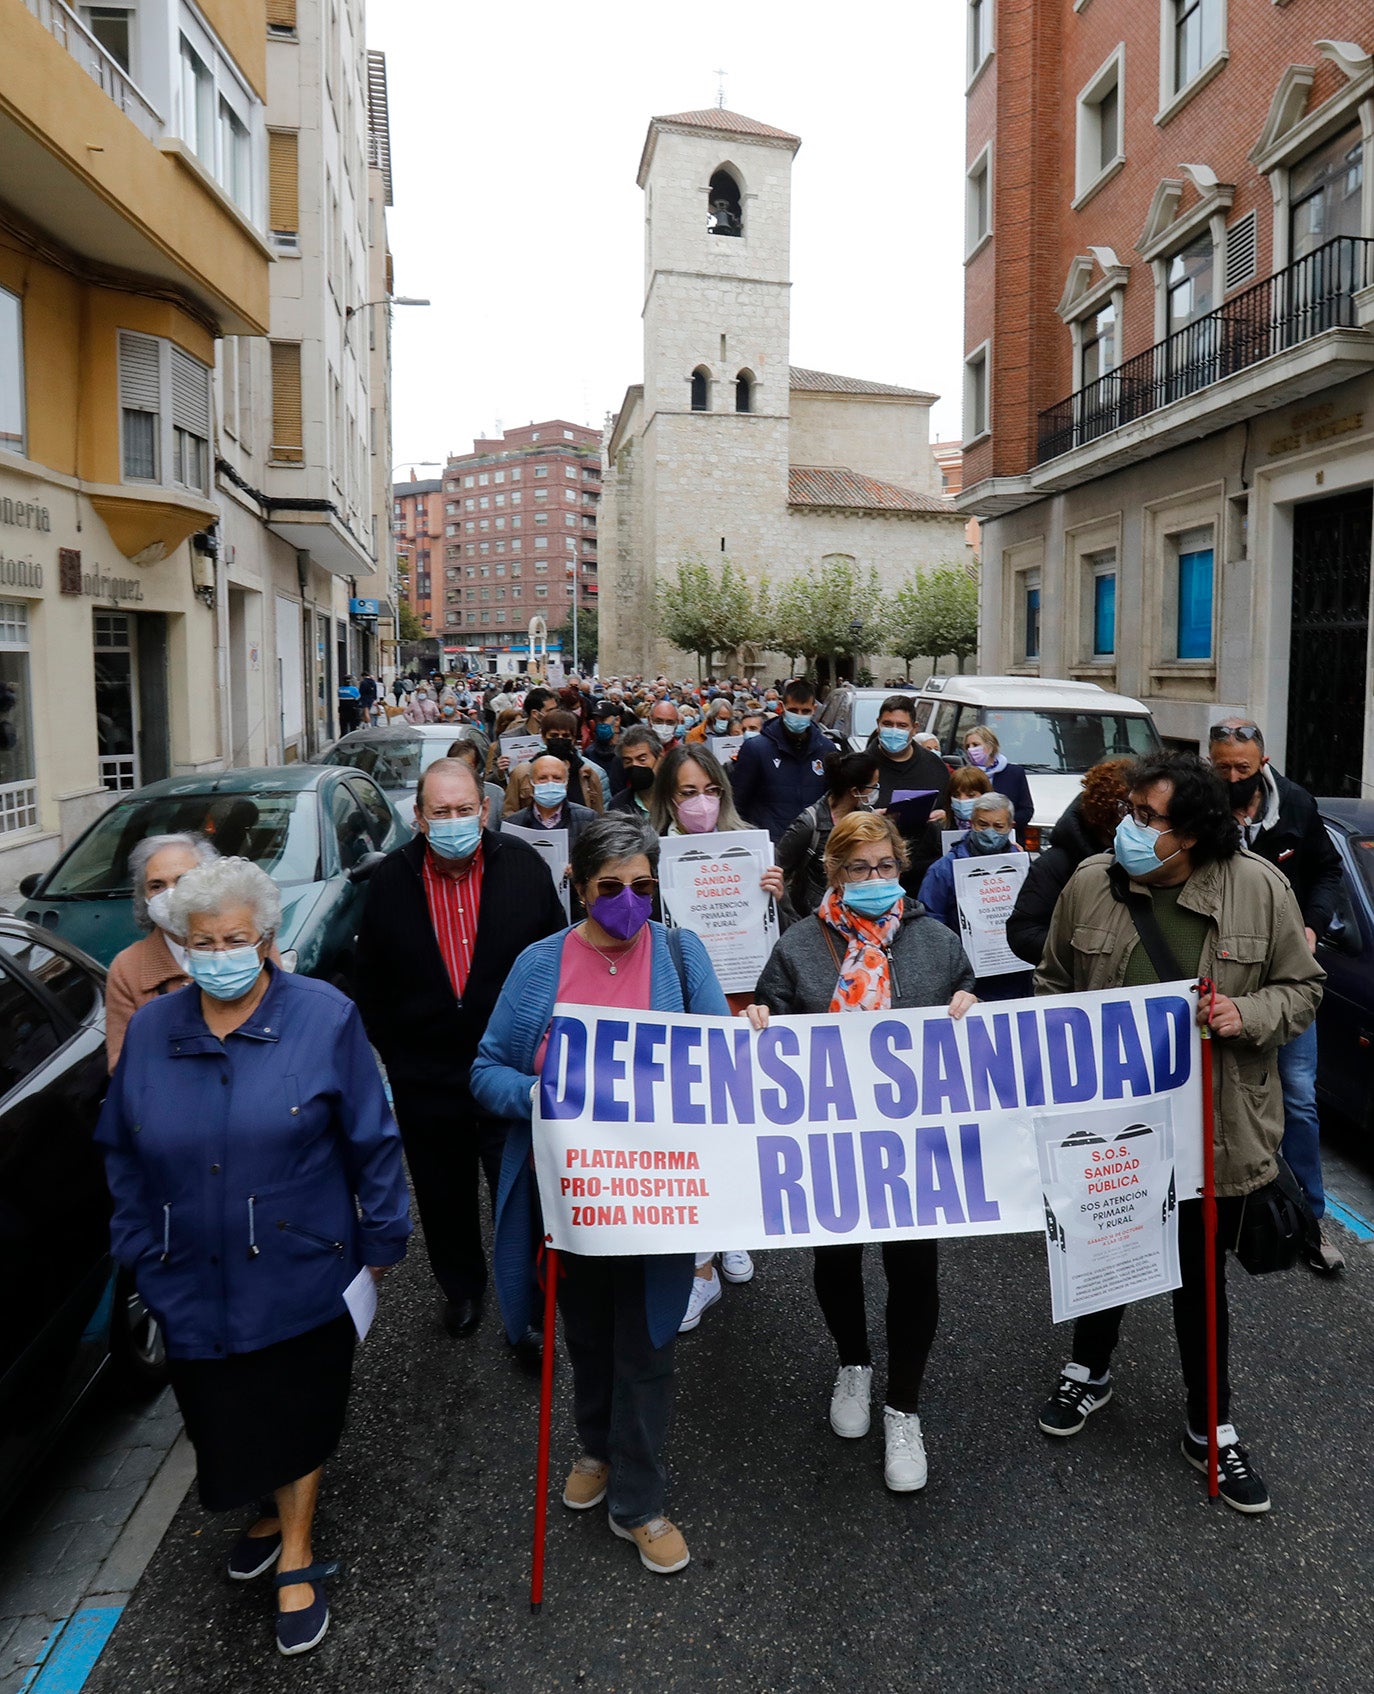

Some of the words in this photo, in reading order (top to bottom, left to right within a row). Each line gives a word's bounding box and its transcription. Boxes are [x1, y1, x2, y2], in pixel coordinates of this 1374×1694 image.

[700, 863, 732, 874] S.O.S.
[694, 874, 742, 887] SANIDAD
[979, 886, 1012, 896] SANIDAD
[690, 904, 708, 912] SOS
[540, 1015, 857, 1125] DEFENSA
[870, 995, 1192, 1119] SANIDAD
[566, 1148, 700, 1170] PLATAFORMA
[1092, 1146, 1131, 1162] S.O.S.
[1084, 1158, 1140, 1180] SANIDAD
[560, 1177, 710, 1197] PRO-HOSPITAL
[756, 1123, 1001, 1236] RURAL
[1088, 1174, 1139, 1194] PÚBLICA
[1080, 1201, 1101, 1212] SOS
[1092, 1204, 1135, 1221] PRIMARIA
[572, 1205, 627, 1226] ZONA
[632, 1205, 699, 1225] NORTE
[1098, 1222, 1104, 1230] Y
[1106, 1215, 1133, 1230] RURAL
